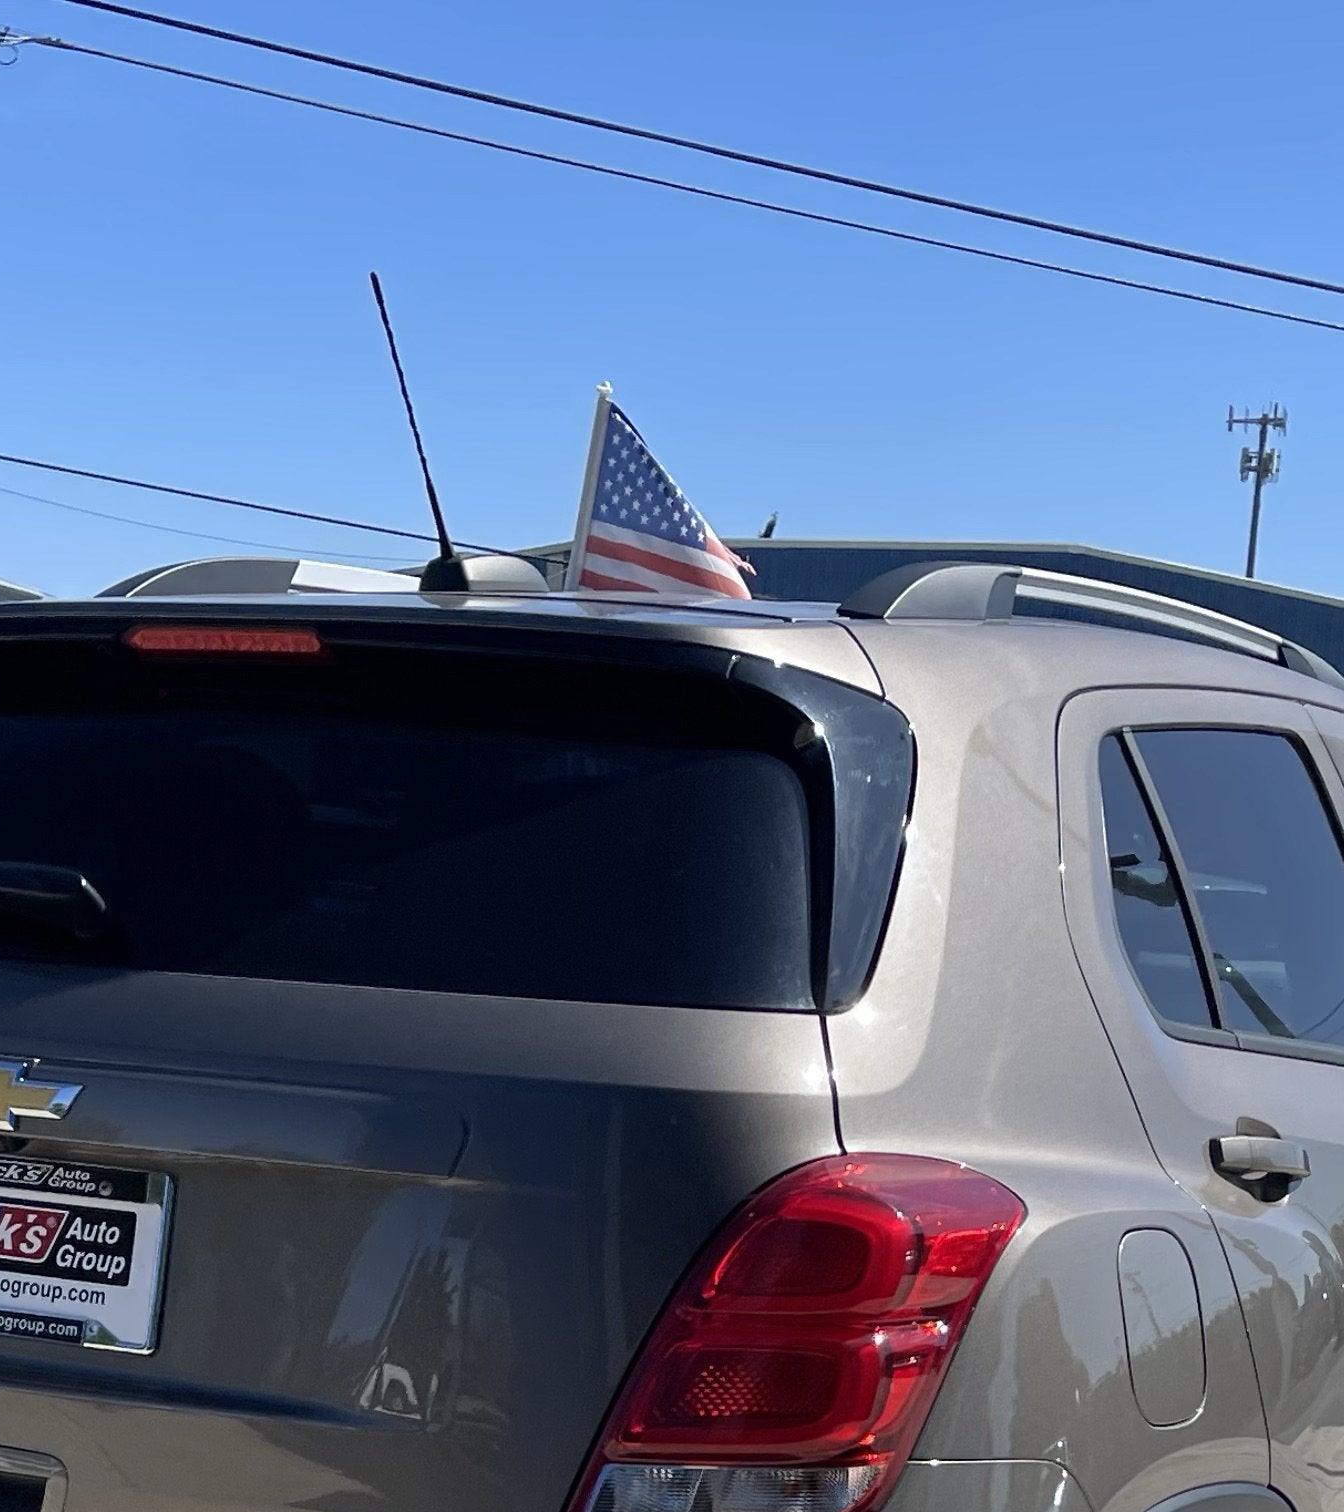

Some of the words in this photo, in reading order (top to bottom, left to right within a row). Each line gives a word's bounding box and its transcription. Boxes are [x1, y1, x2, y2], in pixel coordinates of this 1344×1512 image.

[47, 1176, 96, 1193] Group
[54, 1166, 91, 1181] Auto
[65, 1216, 120, 1245] Auto
[56, 1244, 126, 1279] Group
